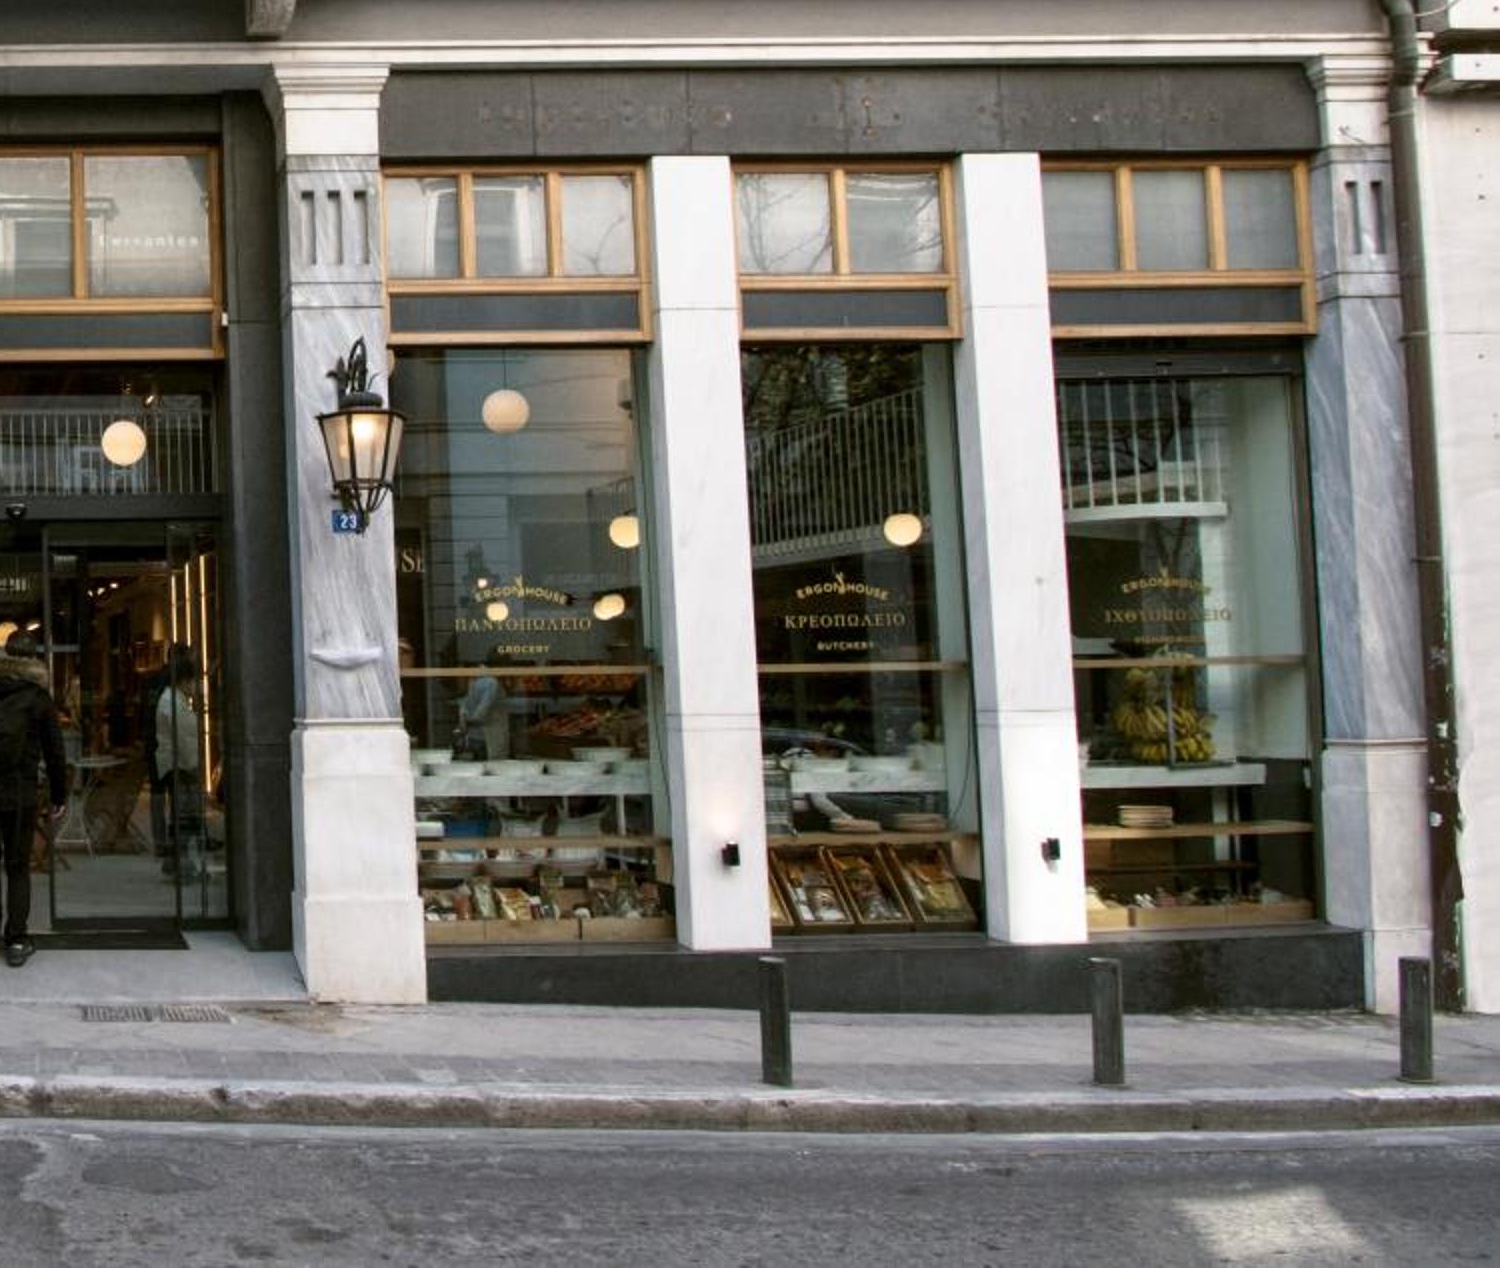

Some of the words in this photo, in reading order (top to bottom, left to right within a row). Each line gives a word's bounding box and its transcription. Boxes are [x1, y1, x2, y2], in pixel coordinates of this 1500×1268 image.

[340, 515, 357, 529] 23
[524, 586, 568, 605] HOUSE
[847, 583, 891, 601] HOUSE
[455, 618, 593, 633] ΠΑΝΤΟΠΩΛΕΙΟ
[784, 613, 907, 630] ΚΡΕΟΠΩΛΕΙΟ
[497, 644, 550, 654] GROCERY
